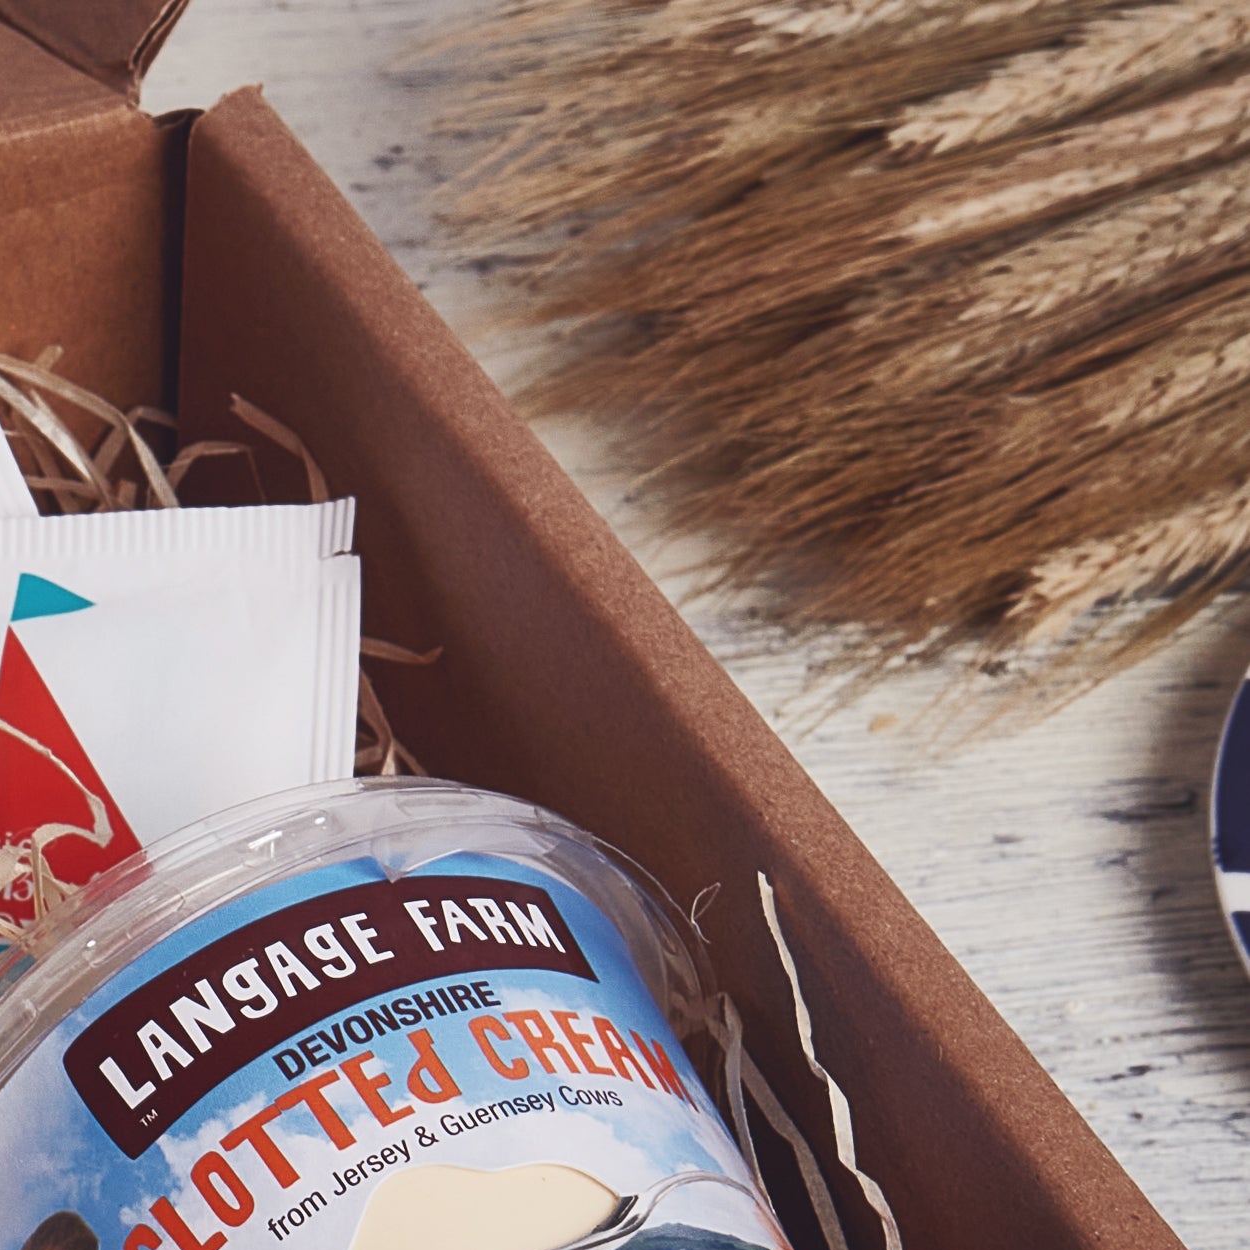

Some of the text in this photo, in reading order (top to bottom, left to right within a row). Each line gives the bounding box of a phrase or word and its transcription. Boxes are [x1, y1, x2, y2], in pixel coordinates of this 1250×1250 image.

[402, 897, 567, 954] FARM
[271, 980, 502, 1082] DEVONSHIRE
[467, 1008, 701, 1115] CREAM
[266, 1085, 624, 1242] from Jersey & Guernsey Cows
